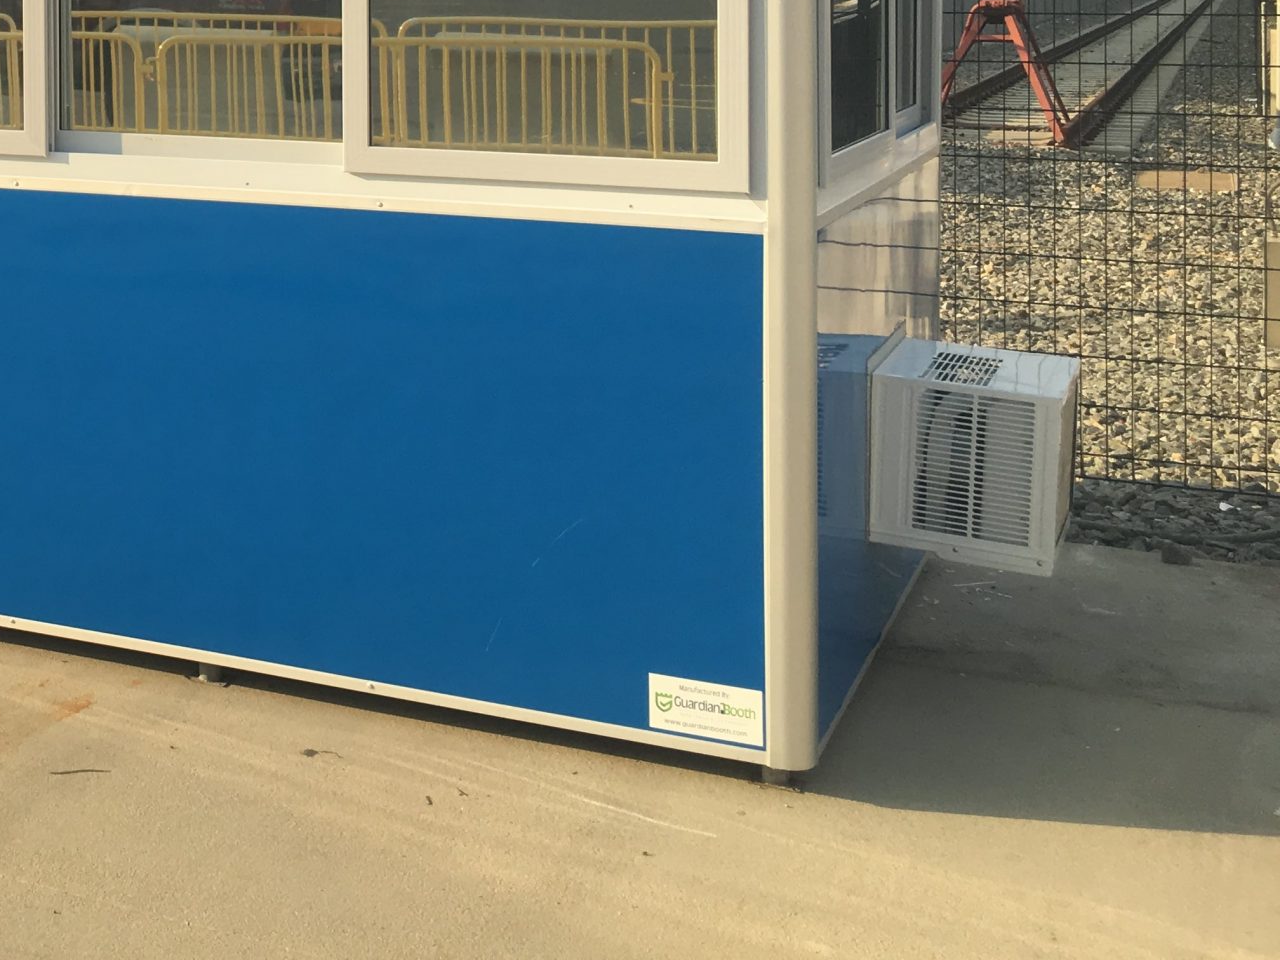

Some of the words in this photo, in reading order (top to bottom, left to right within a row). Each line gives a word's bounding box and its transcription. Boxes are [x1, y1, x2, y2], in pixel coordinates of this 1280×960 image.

[679, 685, 720, 697] Manufactured
[673, 695, 721, 714] Guardian
[724, 703, 756, 720] Booth
[664, 719, 748, 737] www.guardianbooth.com
